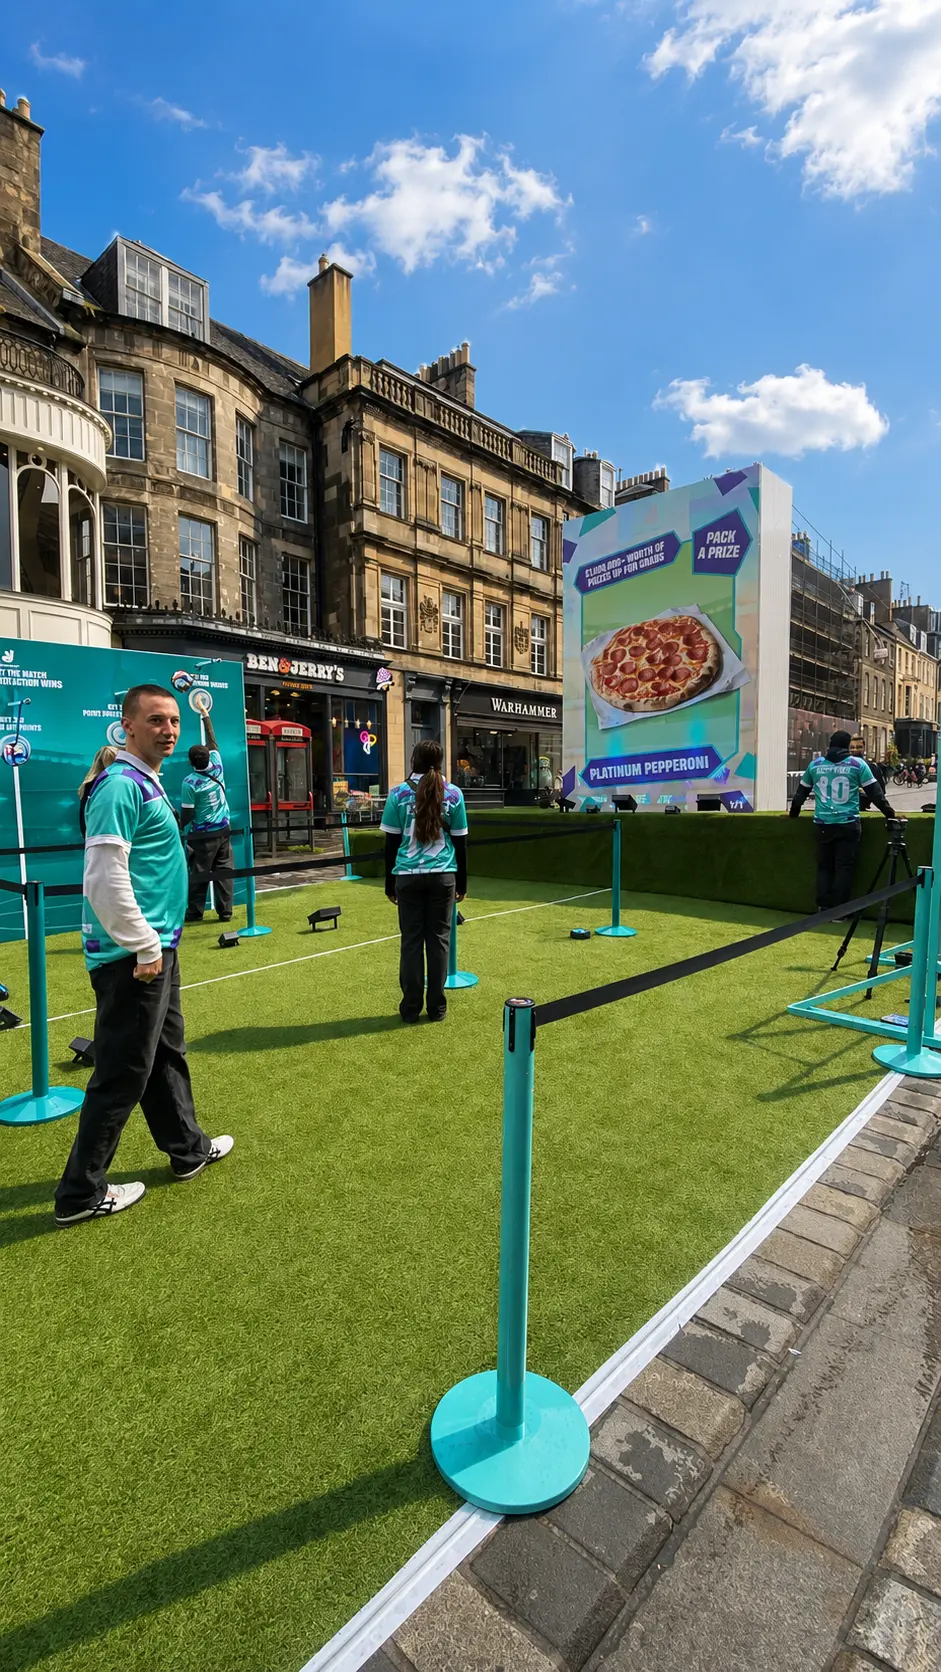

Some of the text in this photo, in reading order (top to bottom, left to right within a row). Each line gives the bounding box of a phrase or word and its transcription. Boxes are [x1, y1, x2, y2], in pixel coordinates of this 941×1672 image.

[706, 530, 737, 544] PACK
[626, 545, 653, 563] WORTH
[654, 541, 664, 552] OF
[697, 545, 740, 559] A PRIZE
[587, 552, 665, 587] PRIZES UP FOR GRABS
[22, 670, 47, 679] MATCH
[491, 697, 557, 718] WARHAMMER
[589, 755, 710, 780] PLATINUM PEPPERONI
[816, 776, 850, 804] 10
